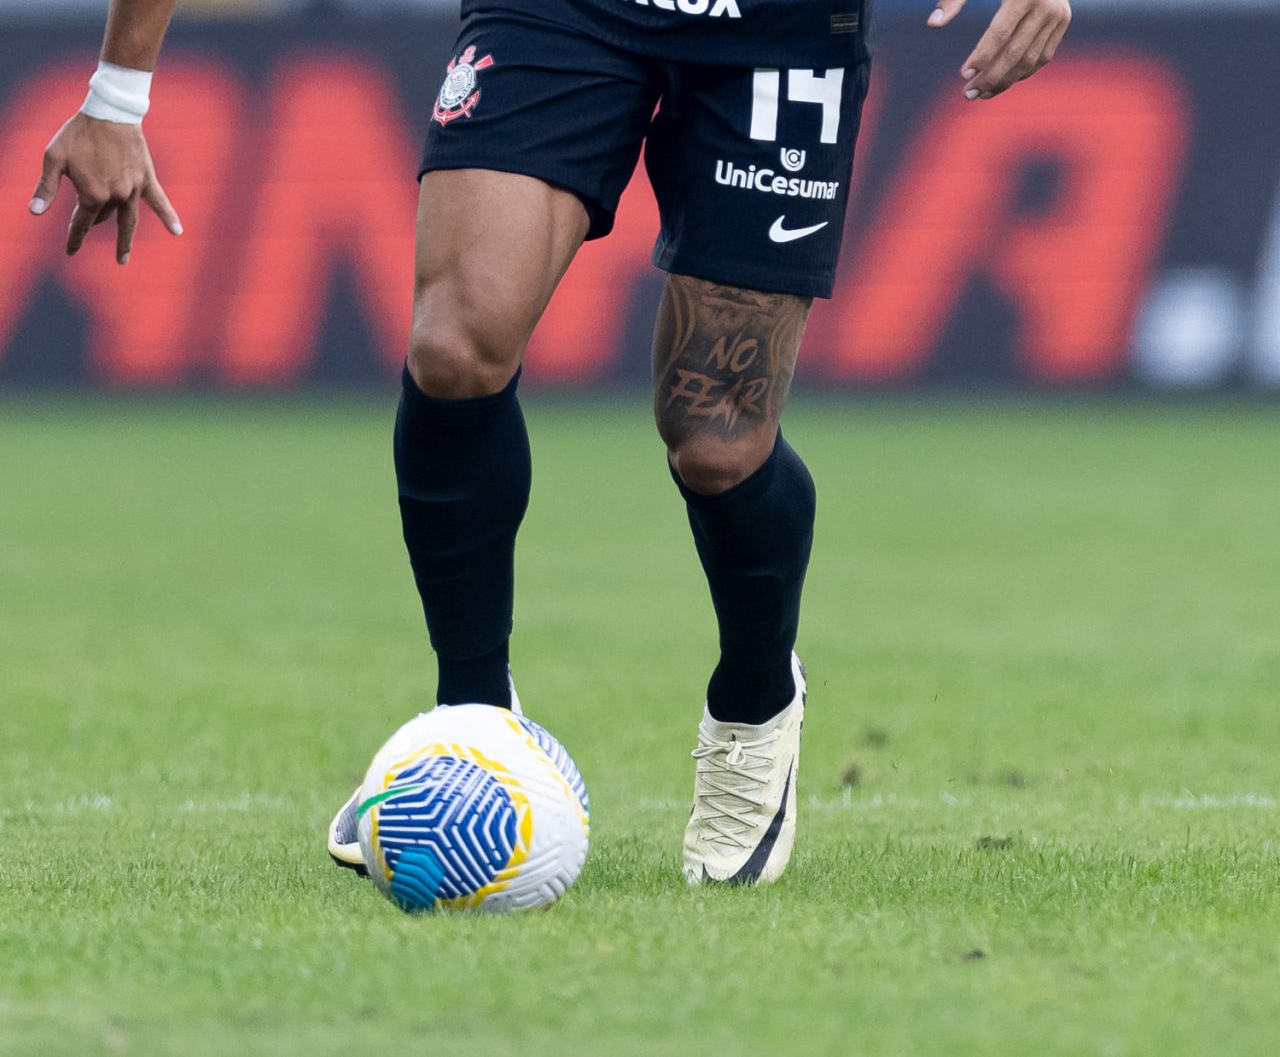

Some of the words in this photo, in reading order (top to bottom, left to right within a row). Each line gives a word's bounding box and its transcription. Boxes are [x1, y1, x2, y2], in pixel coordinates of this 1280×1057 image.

[749, 67, 845, 145] 14
[715, 159, 840, 200] UniCesumar
[704, 324, 759, 374] NO
[670, 367, 770, 433] FEAR
